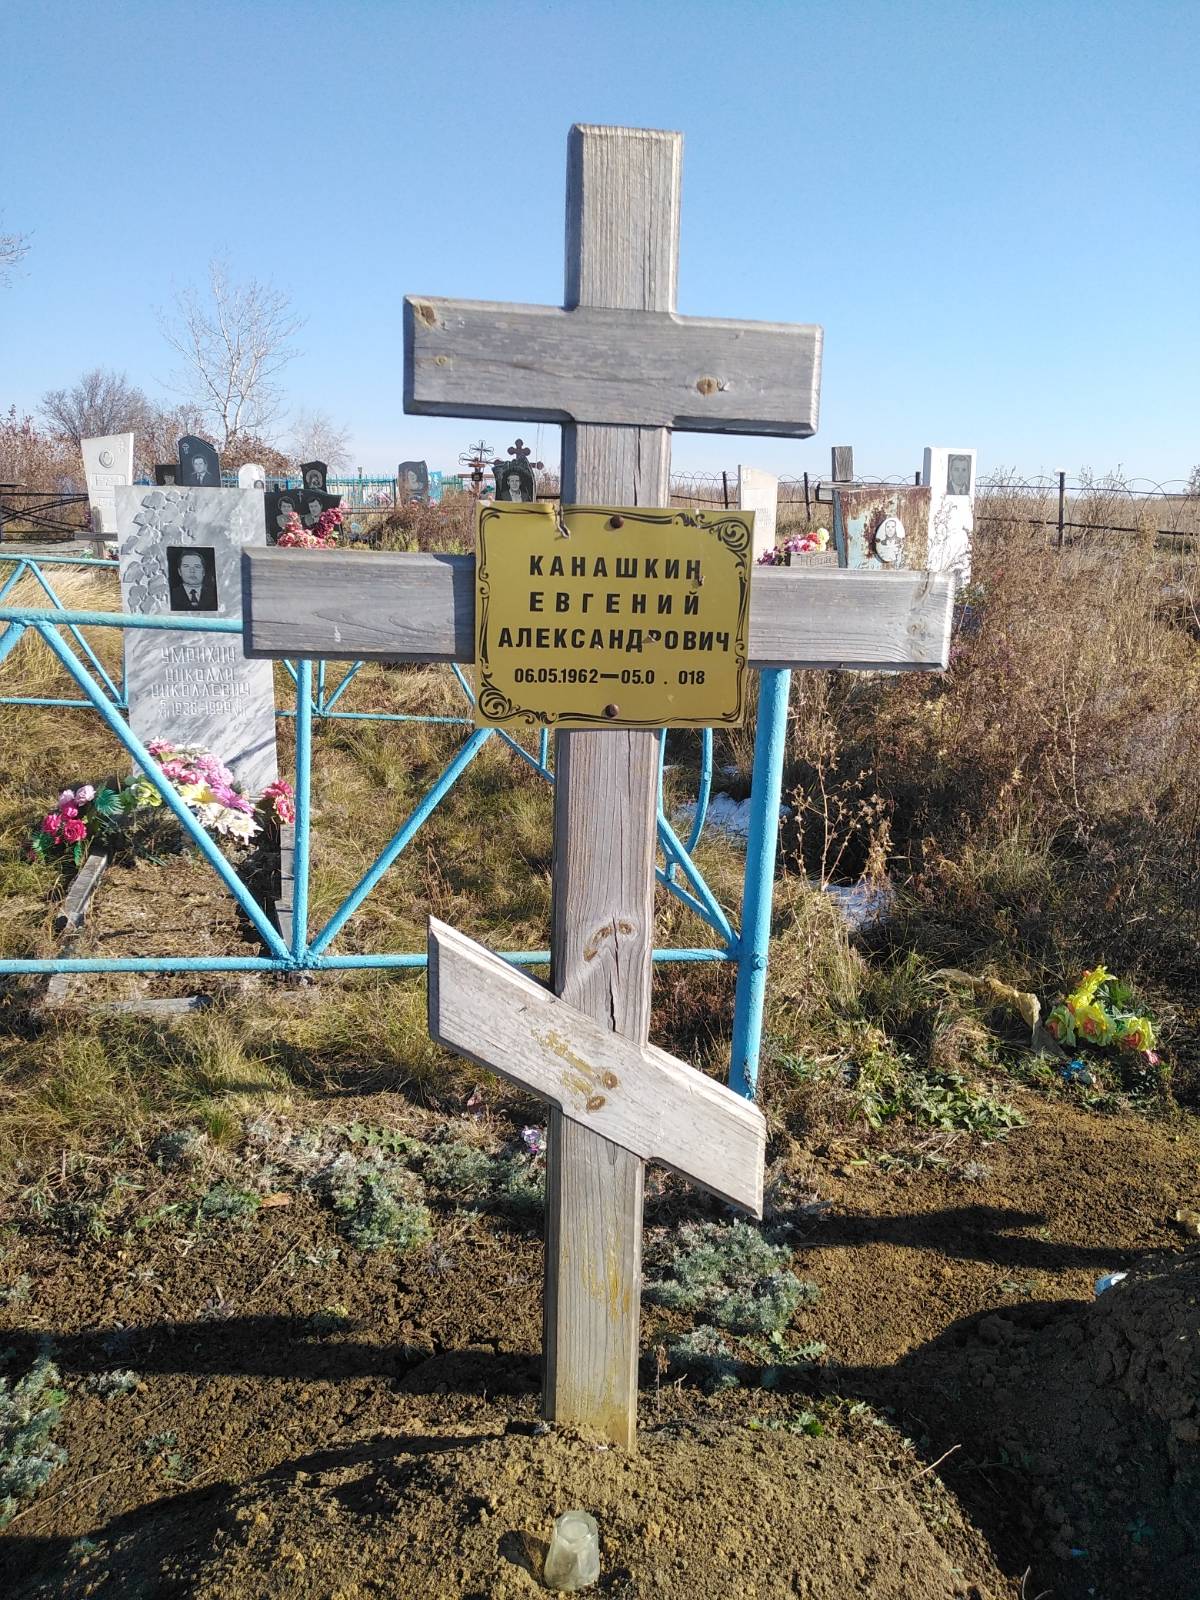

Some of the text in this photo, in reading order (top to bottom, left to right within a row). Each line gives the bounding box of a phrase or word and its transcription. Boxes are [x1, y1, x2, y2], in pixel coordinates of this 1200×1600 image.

[530, 555, 701, 580] КАНАШКИН
[529, 590, 699, 615] ЕВГЕНИЙ
[498, 627, 729, 653] АЛЕКСАНДРОВИЧ
